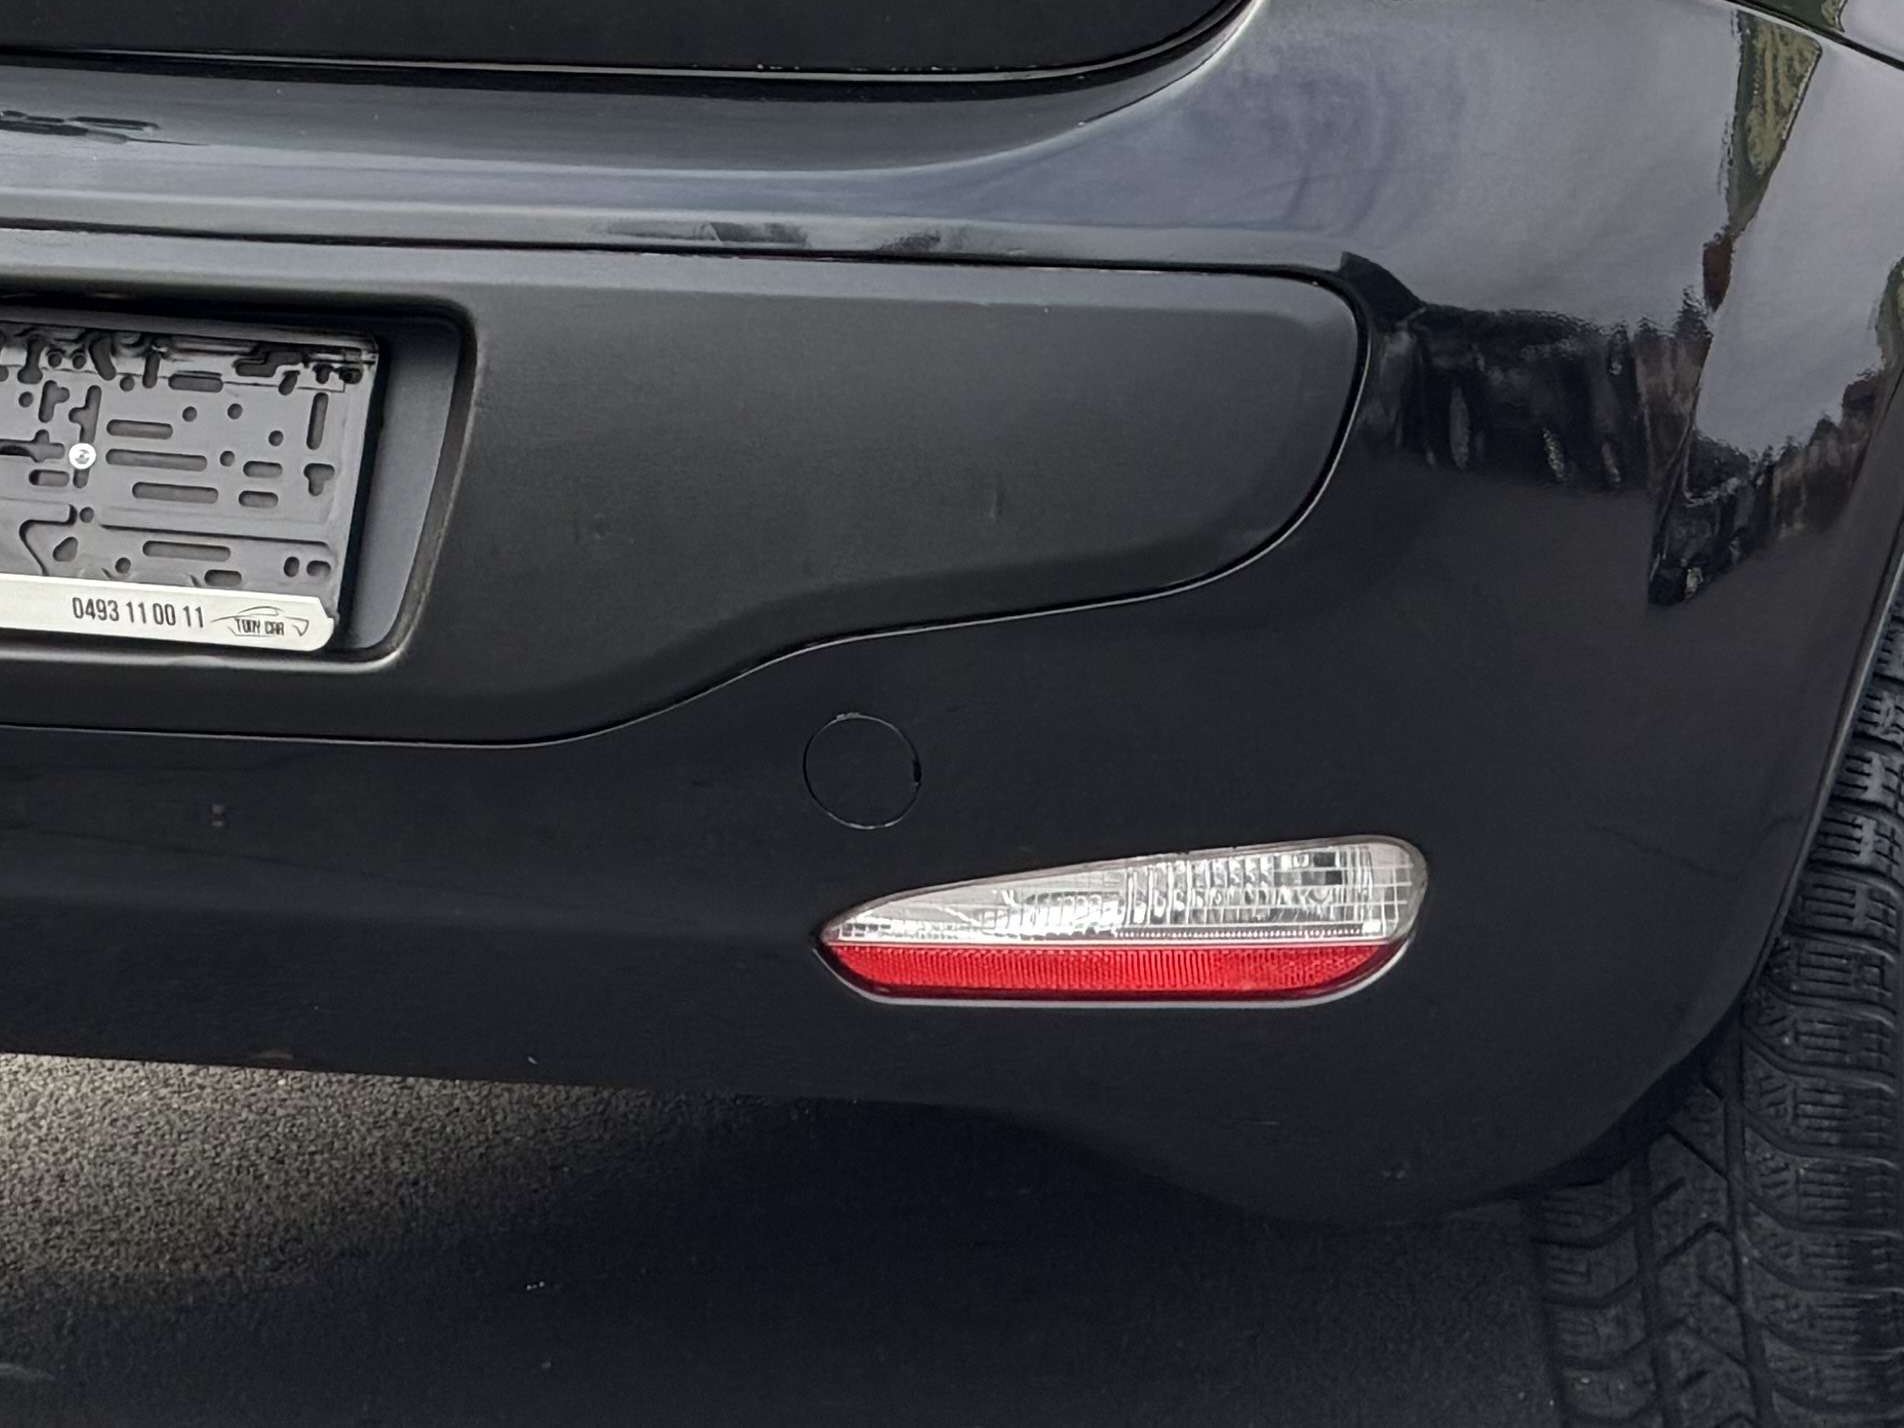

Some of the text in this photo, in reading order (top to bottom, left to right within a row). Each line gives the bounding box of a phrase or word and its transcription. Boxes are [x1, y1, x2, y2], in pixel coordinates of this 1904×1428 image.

[71, 596, 205, 629] 0493 11 00 11
